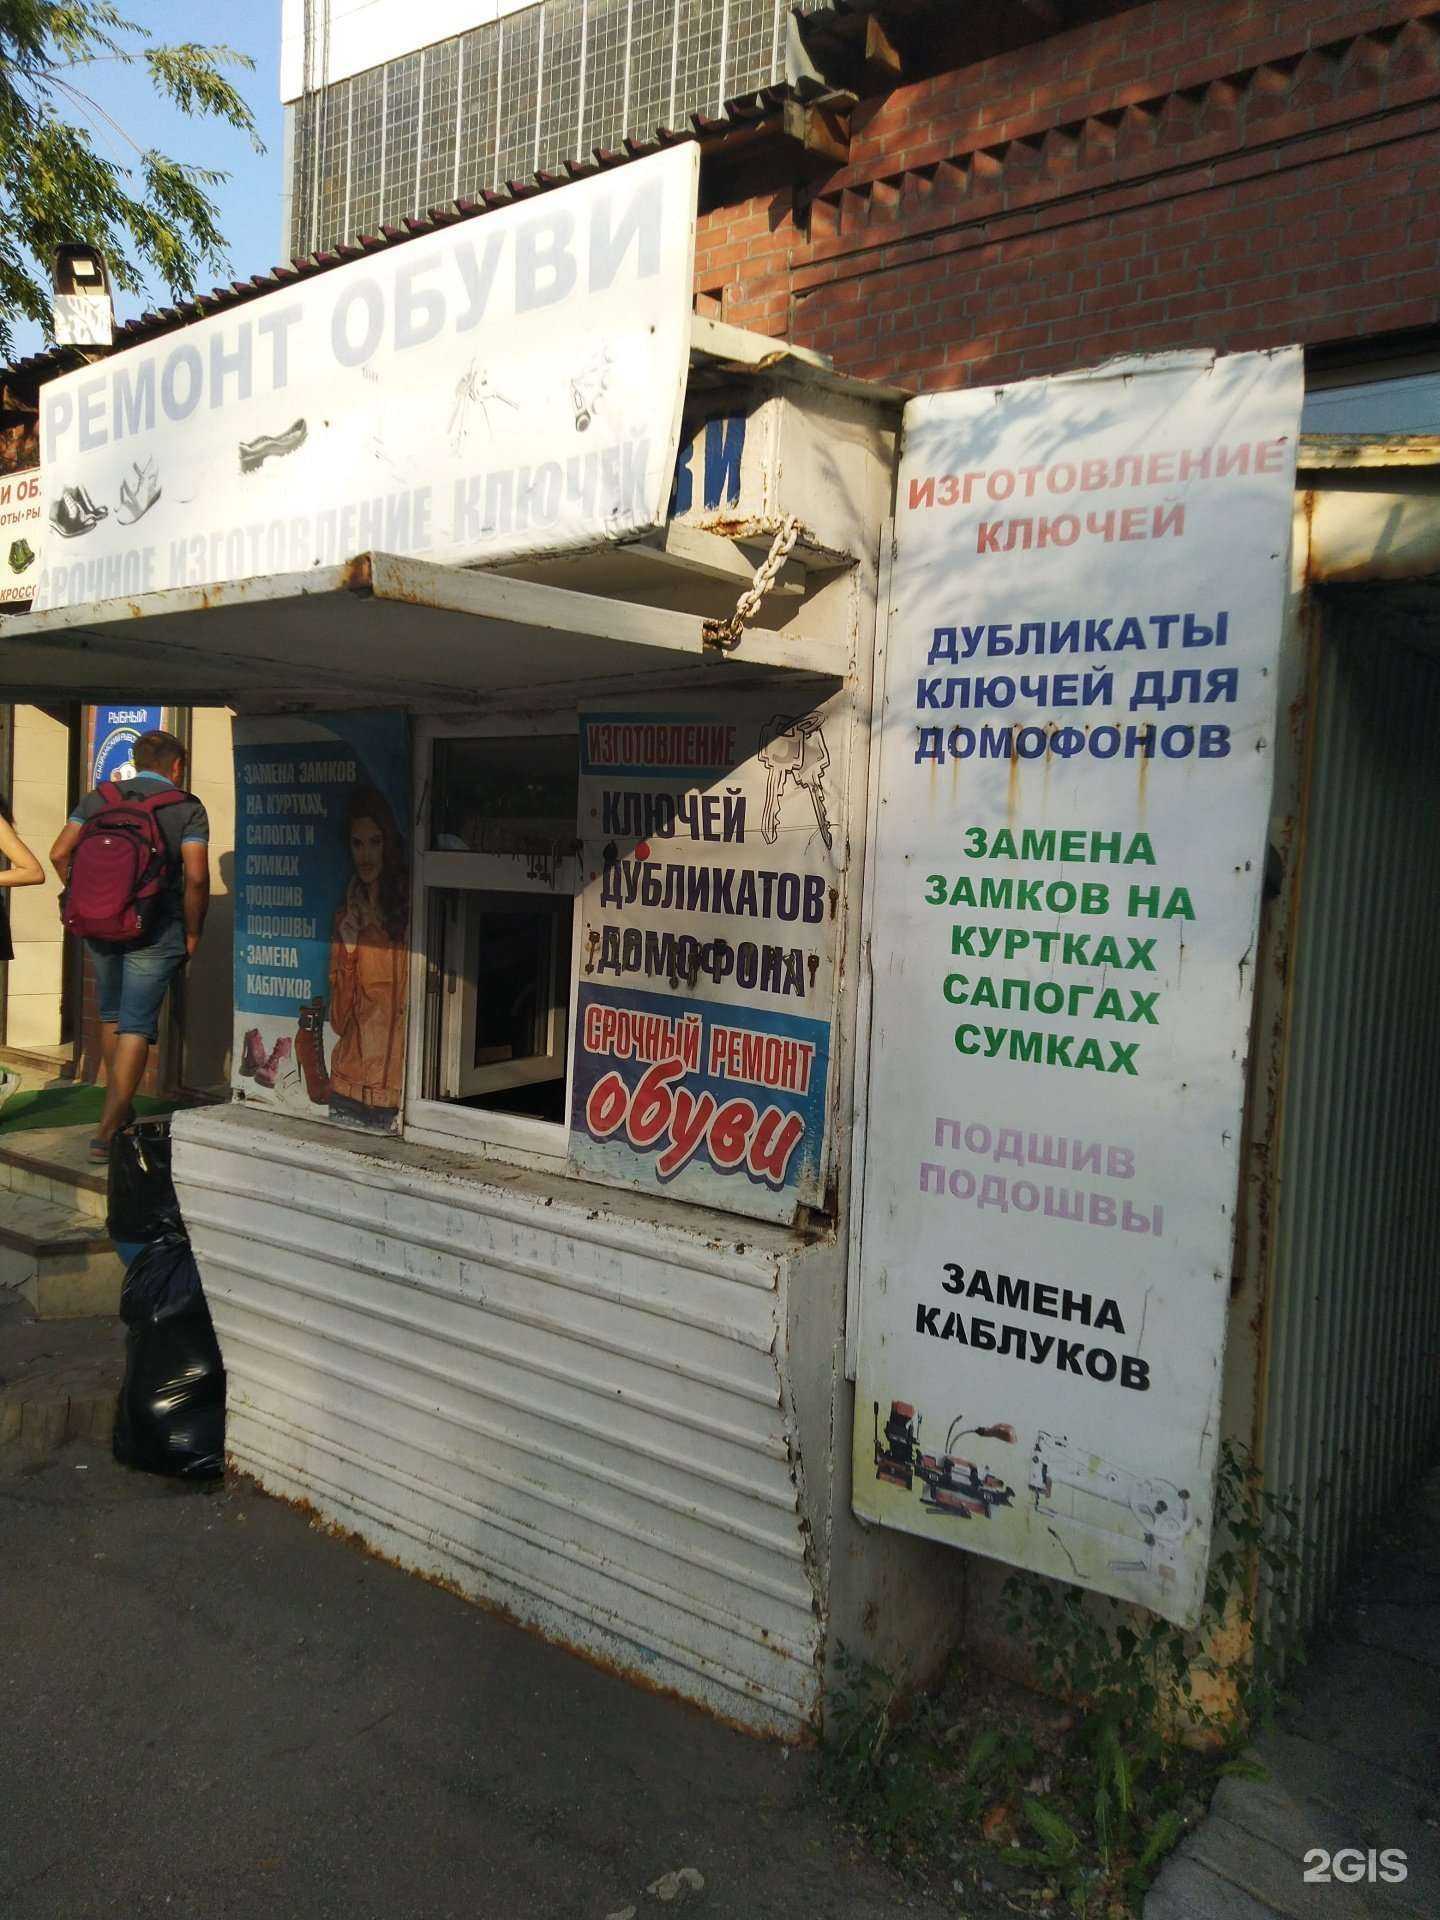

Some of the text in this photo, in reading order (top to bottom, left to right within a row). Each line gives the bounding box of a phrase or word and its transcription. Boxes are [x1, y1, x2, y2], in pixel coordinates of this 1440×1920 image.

[46, 176, 665, 463] РЕМОНТ ОБУВИ
[17, 478, 42, 499] ОБ
[908, 438, 1287, 509] ИЗГОТОВЛЕНИЕ
[170, 484, 432, 586] ИЗГОТОВЛЕНИЕ
[453, 422, 650, 543] КЛЮЧЕЙ
[977, 497, 1186, 554] КЛЮЧЕЙ
[927, 611, 1230, 665] ДУБЛИКАТЫ
[916, 665, 1239, 711] КЛЮЧЕЙ ДЛЯ
[108, 709, 148, 724] РЫБНЫЙ
[587, 723, 737, 766] ИЗГОТОВЛЕНИЕ
[914, 723, 1232, 764] ДОМОФОНОВ
[244, 761, 356, 784] ЗАМЕНА ЗАМКОВ
[246, 795, 263, 815] НА
[602, 787, 746, 843] КЛЮЧЕЙ
[246, 825, 314, 846] САПОГАХ И
[963, 826, 1157, 865] ЗАМЕНА
[246, 855, 299, 876] СУМКАХ
[246, 886, 303, 909] ПОДШИВ
[600, 860, 826, 923] ДУБЛИКАТОВ
[925, 874, 1197, 921] ЗАМКОВ НА
[247, 915, 316, 939] ПОДОШВЫ
[951, 924, 1158, 971] КУРТКАХ
[247, 945, 298, 968] ЗАМЕНА
[597, 925, 806, 997] ДОМОФОНА
[246, 975, 311, 999] КАБЛУКОВ
[943, 974, 1160, 1025] САПОГАХ
[585, 1004, 815, 1094] СРОЧНЫЙ РЕМОНТ
[954, 1024, 1140, 1075] СУМКАХ
[587, 1056, 805, 1184] обуви
[934, 1117, 1136, 1179] ПОДШИВ
[919, 1162, 1164, 1237] ПОДОШВЫ
[941, 1263, 1126, 1334] ЗАМЕНА
[915, 1304, 1151, 1392] КАБЛУКОВ
